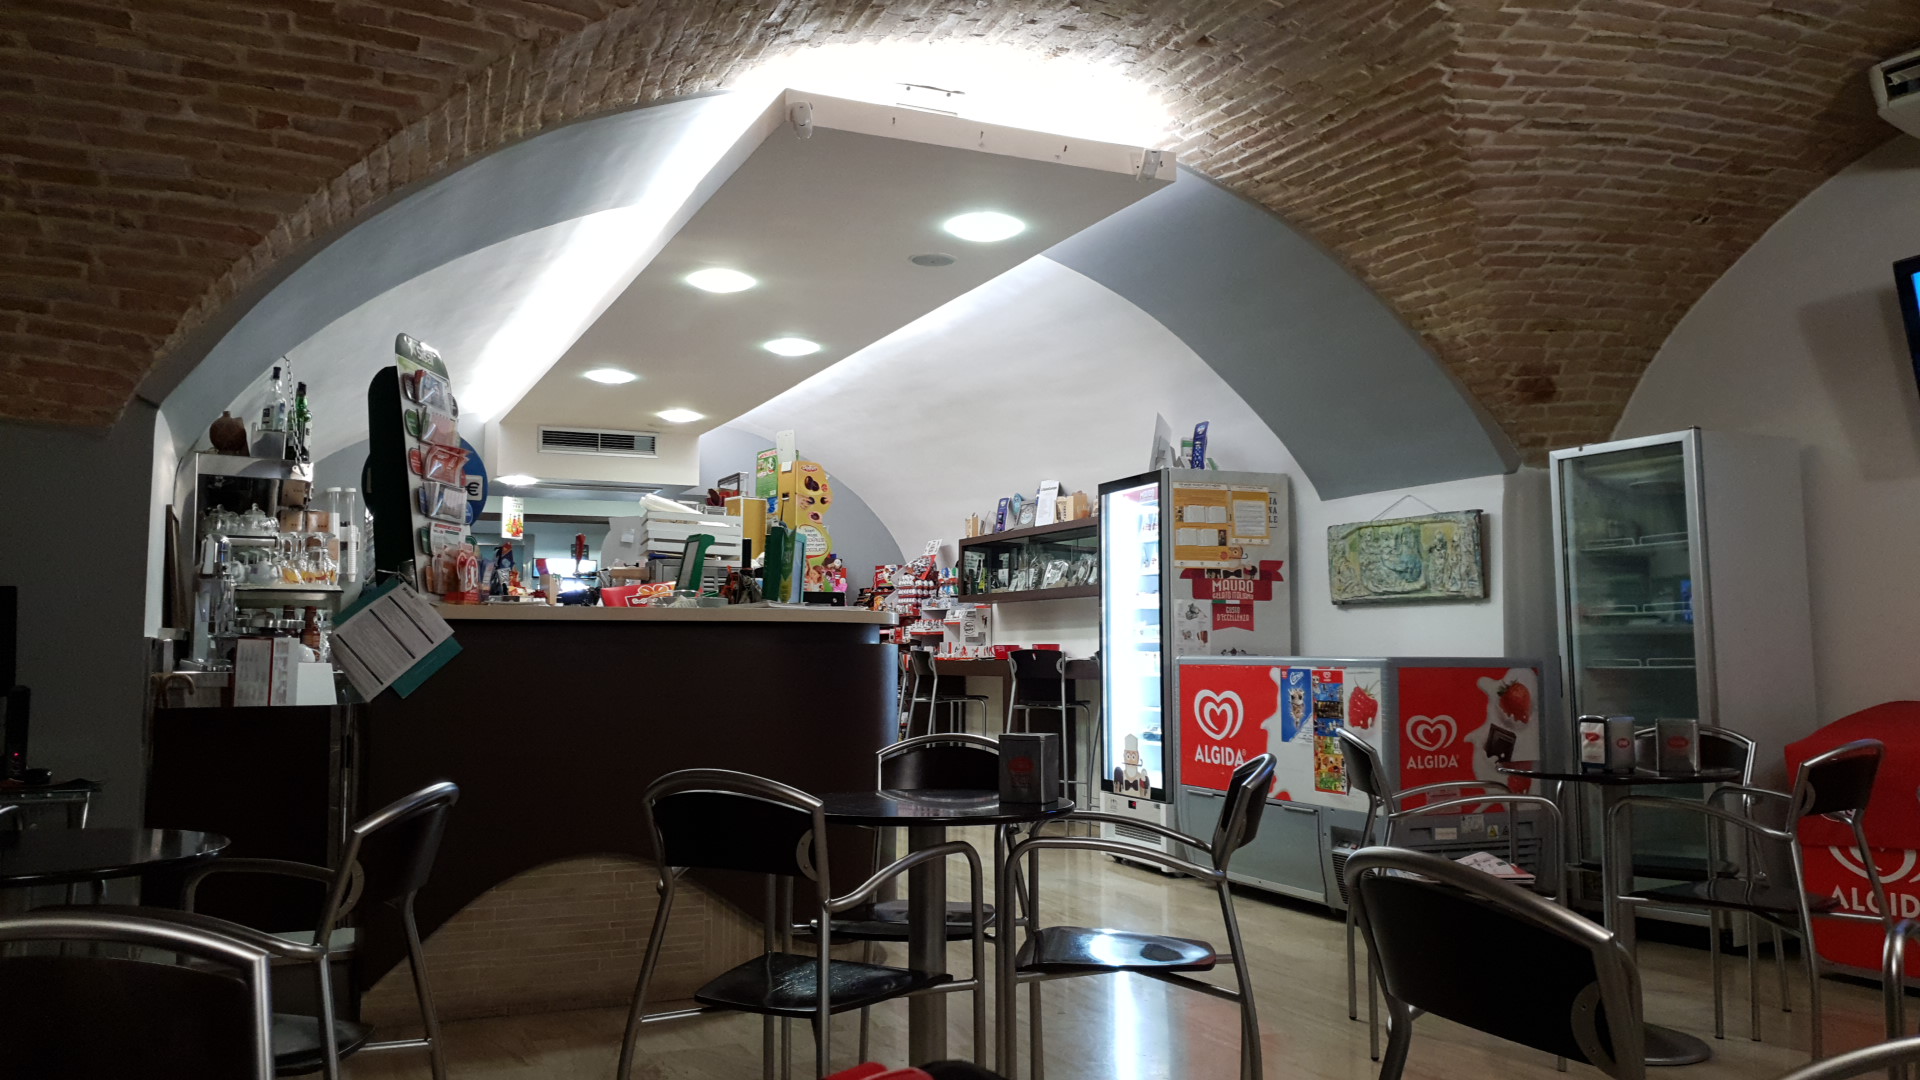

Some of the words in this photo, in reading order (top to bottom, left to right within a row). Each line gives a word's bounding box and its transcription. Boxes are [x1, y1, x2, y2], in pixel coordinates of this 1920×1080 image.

[1212, 579, 1254, 593] MAURO
[1195, 744, 1245, 767] ALGIDA
[1407, 754, 1458, 769] ALGIDA
